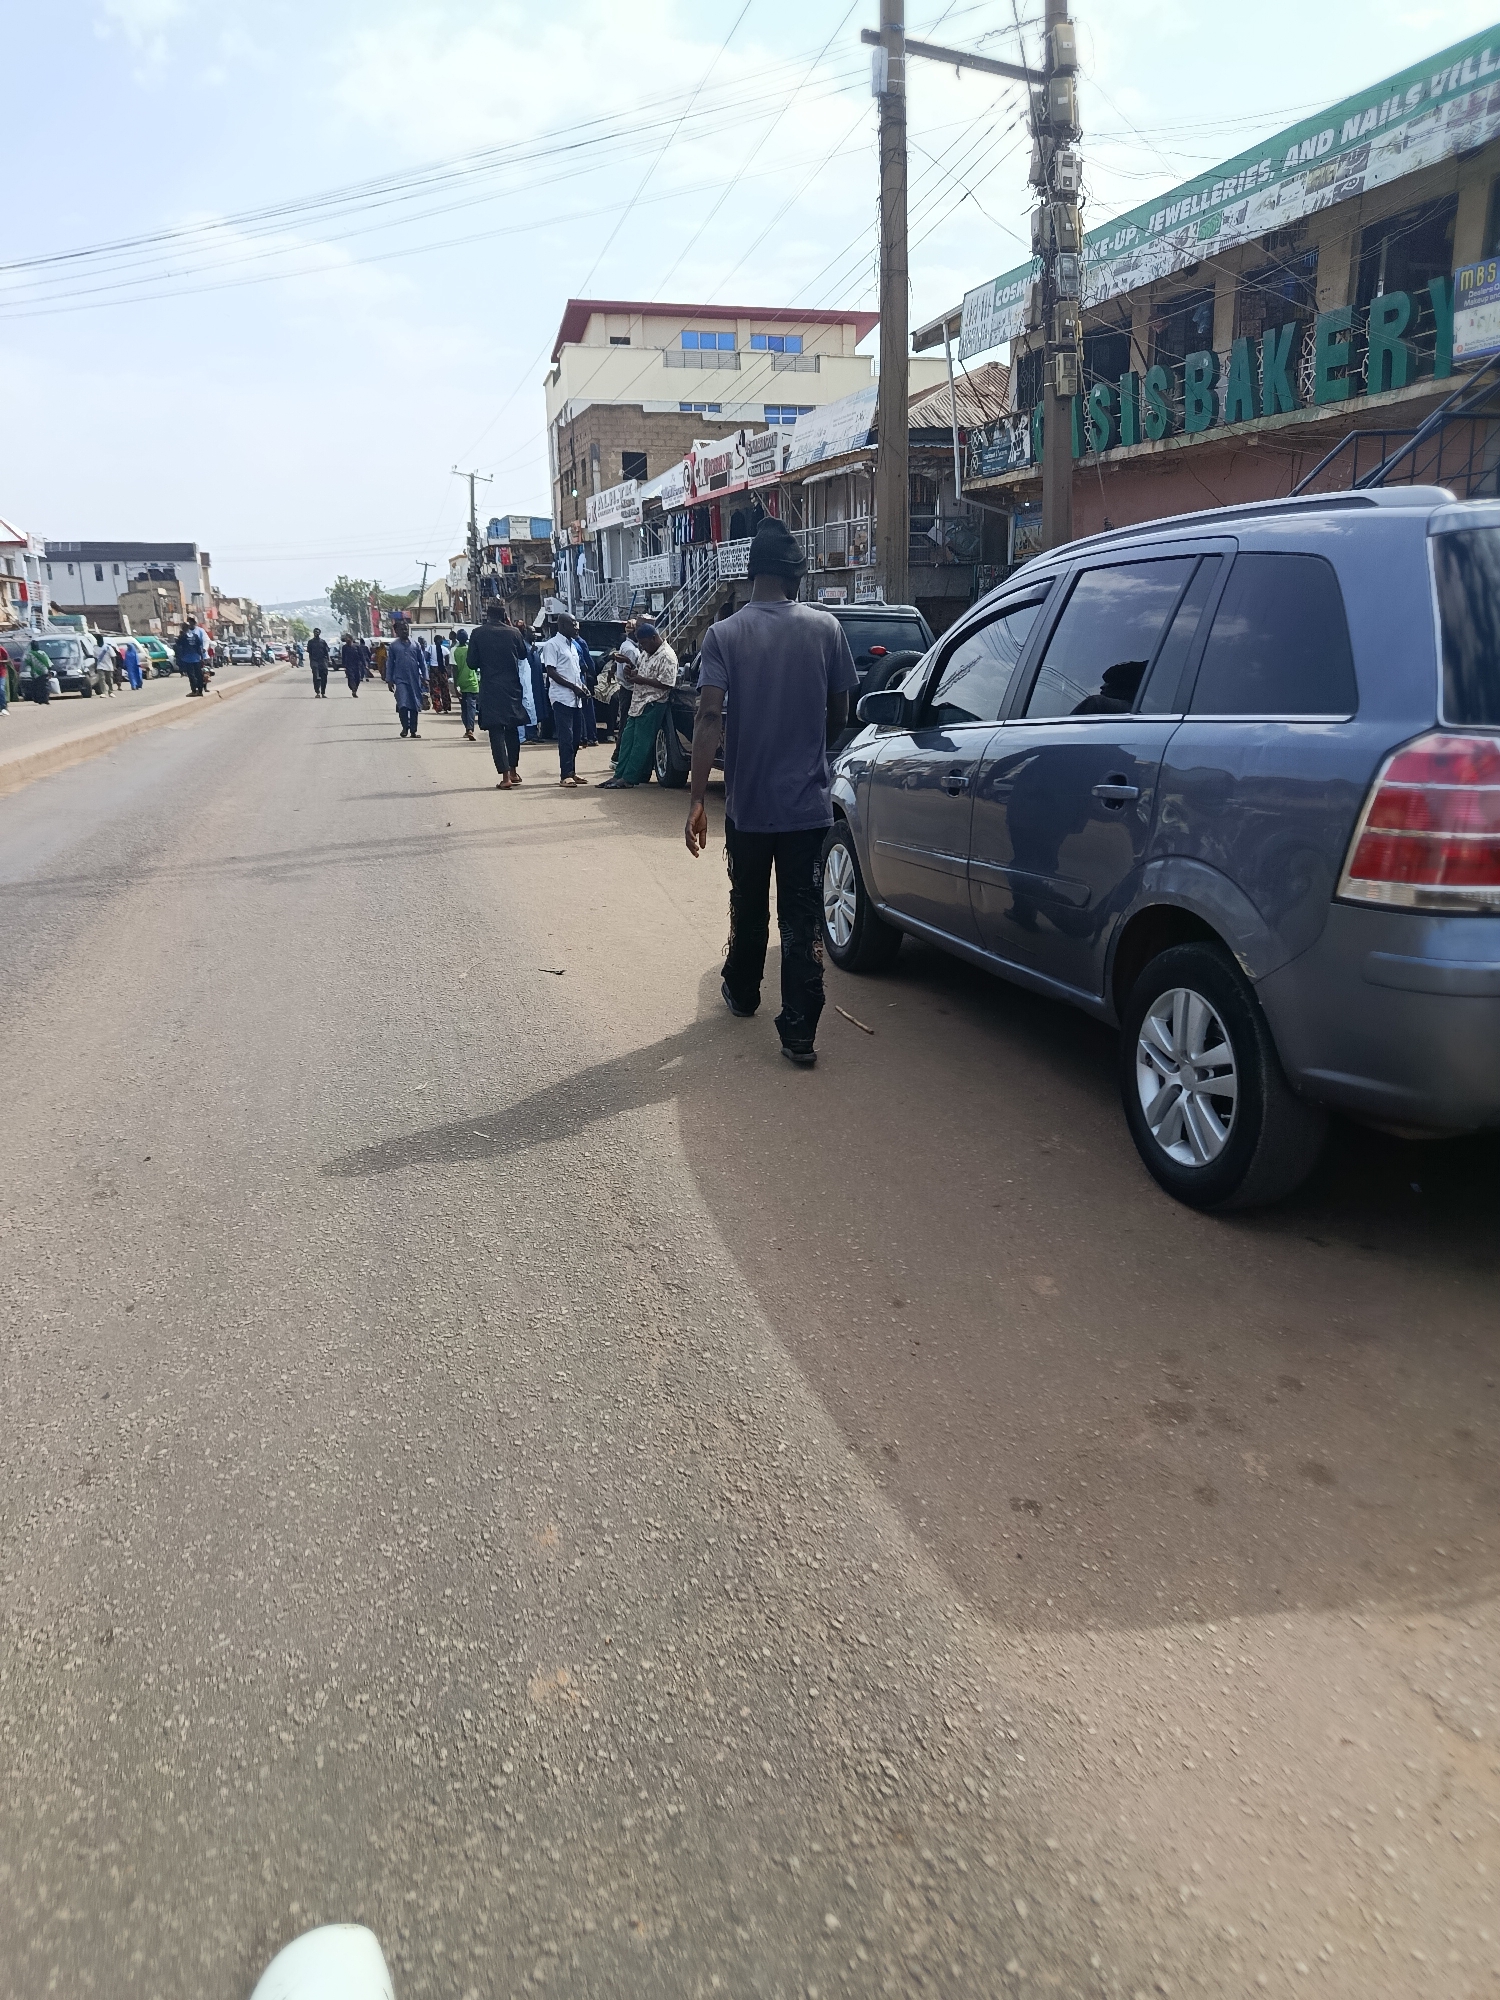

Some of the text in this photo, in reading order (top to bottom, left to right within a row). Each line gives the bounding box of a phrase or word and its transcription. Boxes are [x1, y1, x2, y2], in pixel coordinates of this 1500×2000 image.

[1081, 224, 1140, 264] AKE-UP,
[1146, 157, 1275, 236] JEWELLERIES,
[1283, 128, 1335, 172] AND
[1341, 81, 1423, 145] NAILS
[1185, 274, 1455, 434] BAKERY
[1460, 262, 1497, 292] MBS
